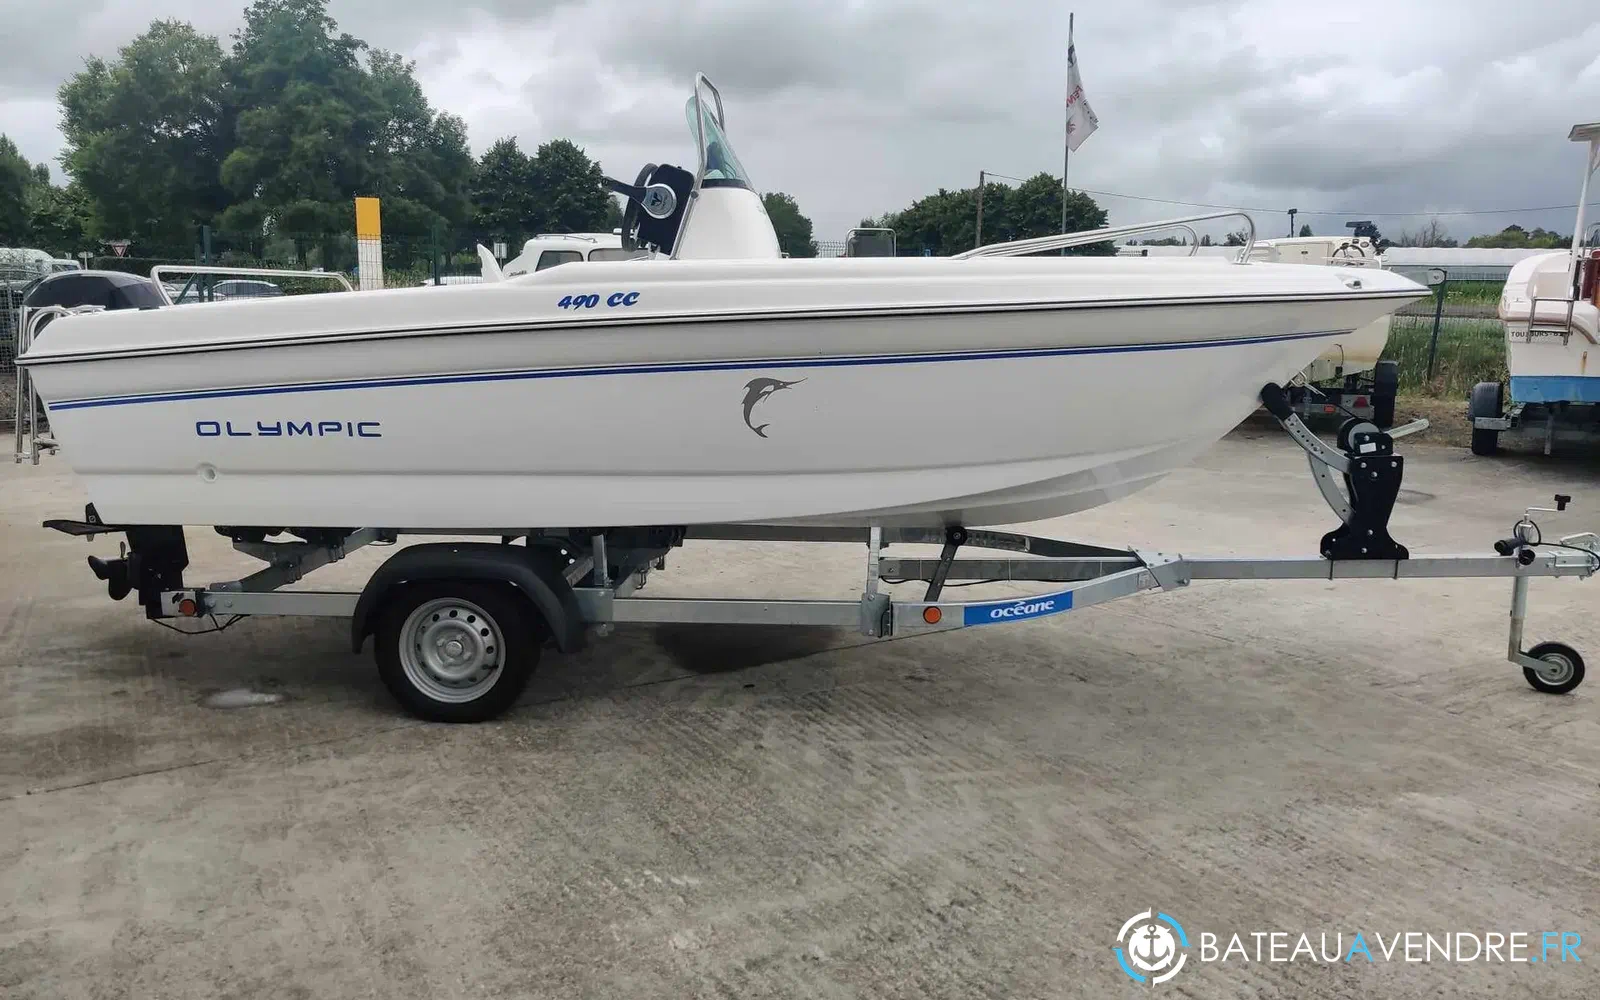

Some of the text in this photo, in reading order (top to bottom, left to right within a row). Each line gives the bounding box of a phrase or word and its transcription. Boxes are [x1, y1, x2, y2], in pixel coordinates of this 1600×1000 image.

[557, 291, 641, 311] 490 CC
[195, 421, 382, 438] OLYMPIC
[990, 600, 1054, 618] océane
